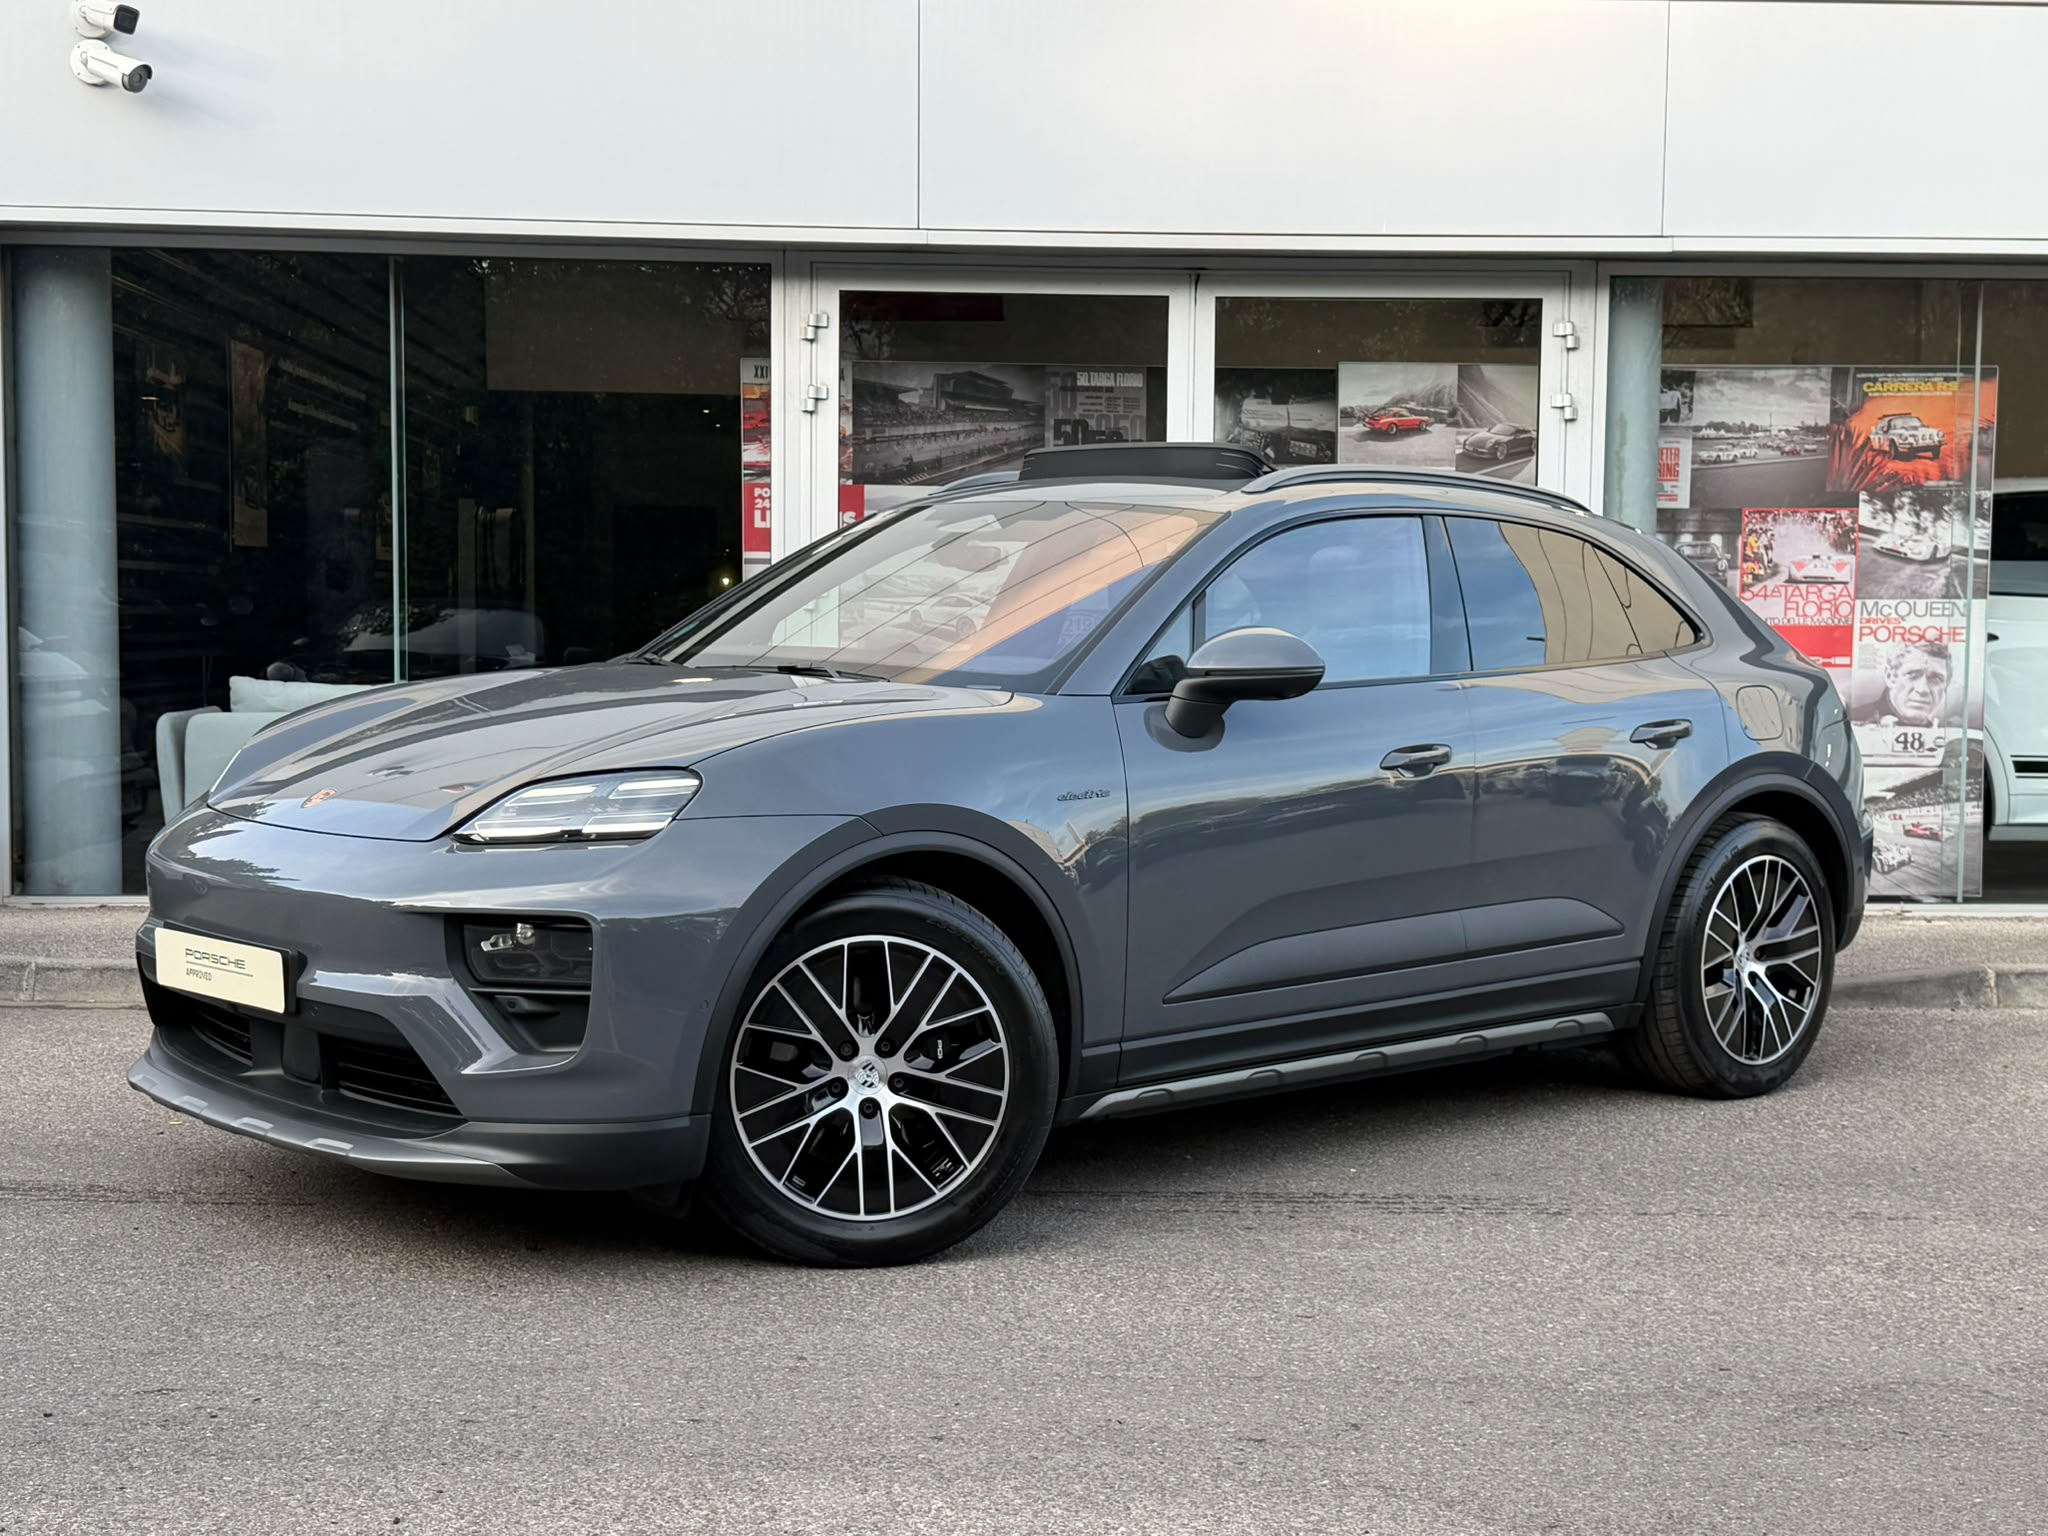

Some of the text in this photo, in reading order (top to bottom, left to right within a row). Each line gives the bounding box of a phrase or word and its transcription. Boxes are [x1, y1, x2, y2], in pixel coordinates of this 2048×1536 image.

[1863, 382, 1936, 393] CARRERA
[1778, 584, 1854, 602] TARGA
[1784, 601, 1853, 618] FLORIO
[1860, 600, 1967, 621] McQUEEN
[1859, 617, 1902, 625] DRIVES
[1858, 625, 1968, 643] PORSCHE
[1894, 731, 1925, 751] 48
[185, 948, 246, 970] PORSCHE
[186, 967, 213, 982] APPROVED
